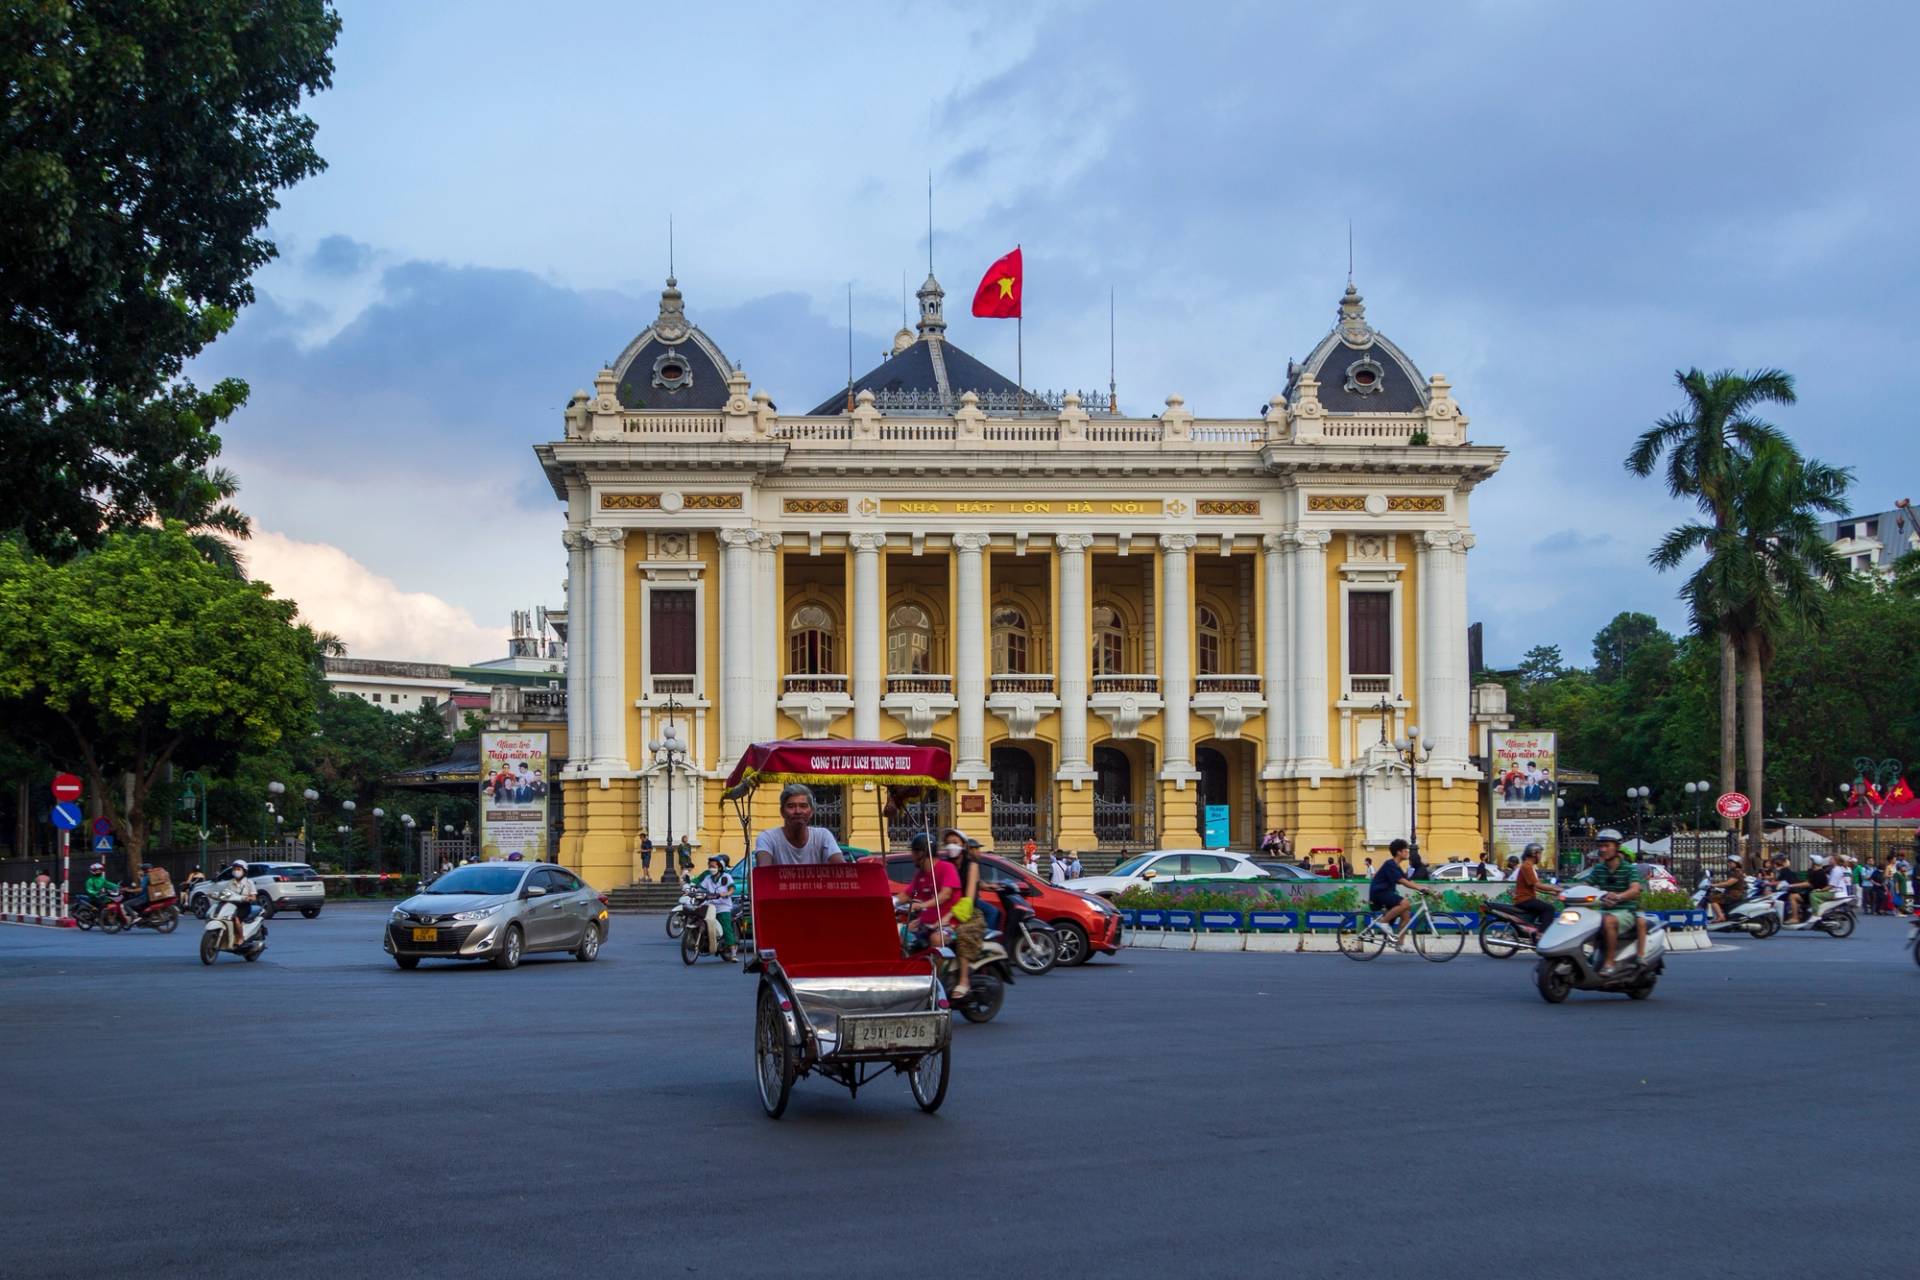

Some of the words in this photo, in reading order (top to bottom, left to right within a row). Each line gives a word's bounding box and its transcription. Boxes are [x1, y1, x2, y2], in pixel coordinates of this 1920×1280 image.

[956, 501, 994, 513] HÁT
[1067, 501, 1094, 513] HÀ
[530, 750, 542, 760] 70
[1538, 749, 1549, 759] 70
[831, 756, 841, 770] TY
[870, 756, 895, 770] TRUNG
